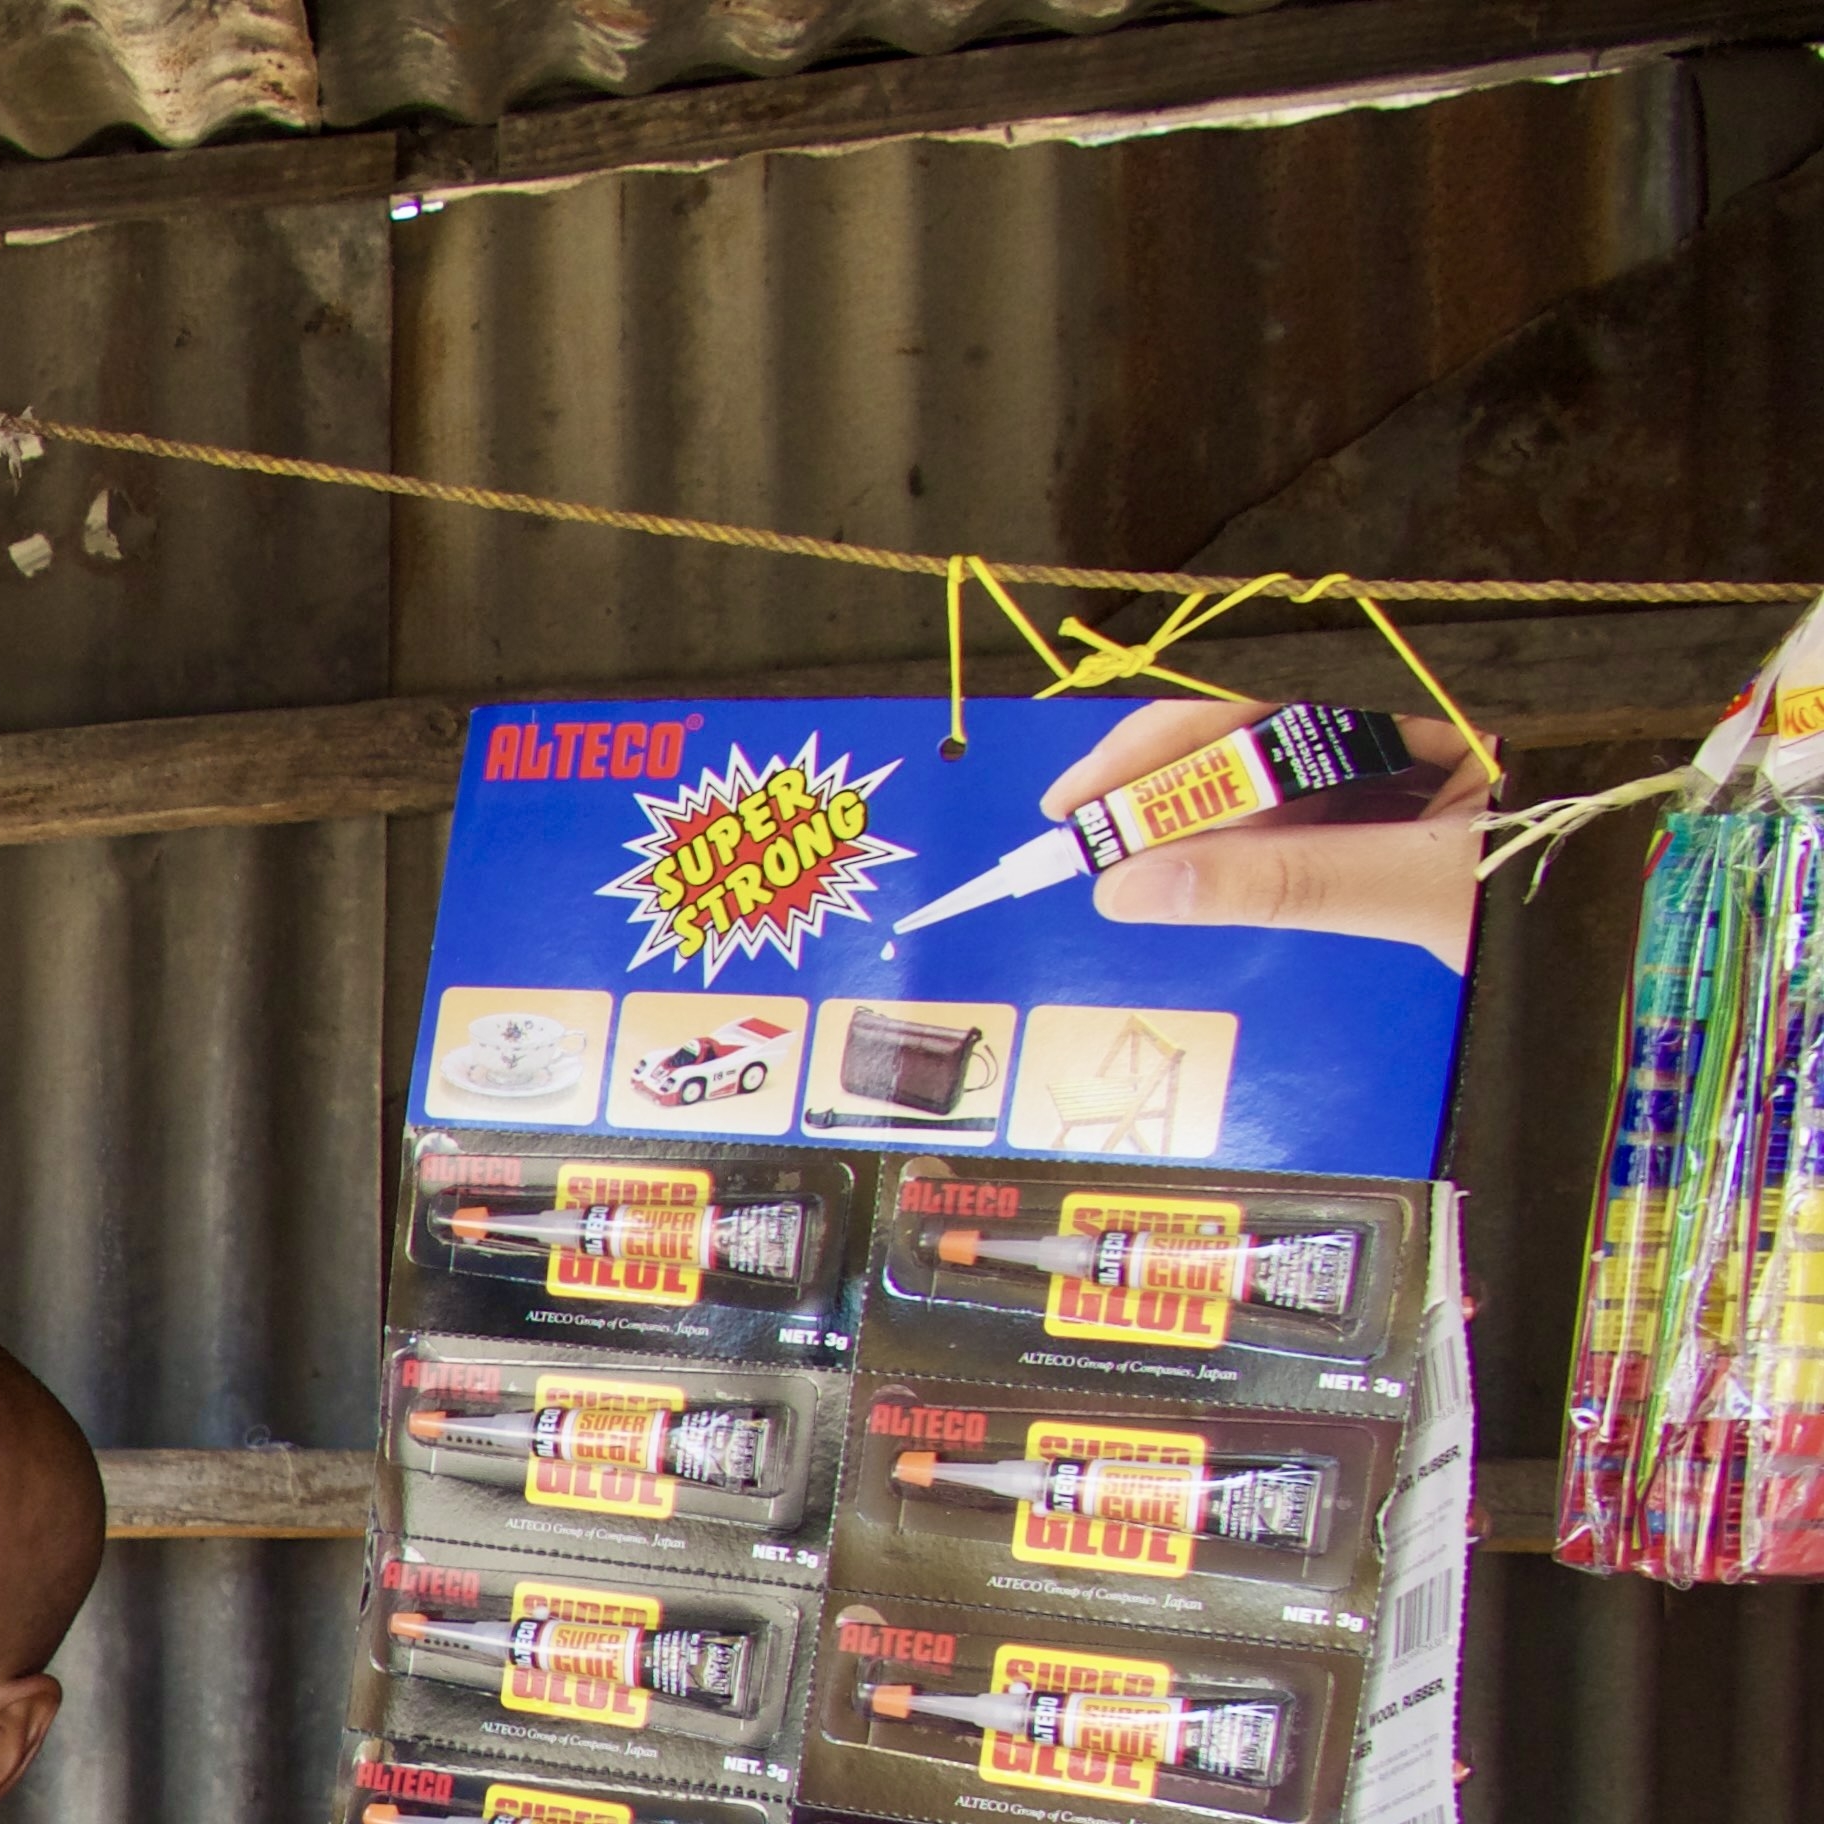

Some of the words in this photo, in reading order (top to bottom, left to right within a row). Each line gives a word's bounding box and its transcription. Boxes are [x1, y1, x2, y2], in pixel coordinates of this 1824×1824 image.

[484, 718, 684, 780] ALTECO
[1131, 745, 1231, 804] SUPER
[1142, 770, 1247, 840] GLUE
[649, 767, 825, 914] SUPER
[674, 789, 869, 961] STRONG
[901, 1181, 1021, 1218] ALTECO
[526, 1308, 573, 1328] ALTECO
[676, 1320, 710, 1338] Japan
[778, 1326, 821, 1347] NET.
[825, 1331, 849, 1351] 3g
[1318, 1372, 1369, 1394] NET.
[1372, 1376, 1403, 1399] 3g
[870, 1404, 989, 1443] ALTECO
[751, 1543, 792, 1564] NET.
[796, 1548, 820, 1569] 3g
[1281, 1606, 1329, 1627] NET.
[1332, 1609, 1365, 1632] 3g
[838, 1623, 957, 1666] ALTECO
[1401, 1677, 1447, 1712] RUBBER,
[723, 1755, 765, 1776] NET.
[767, 1761, 791, 1782] 3g
